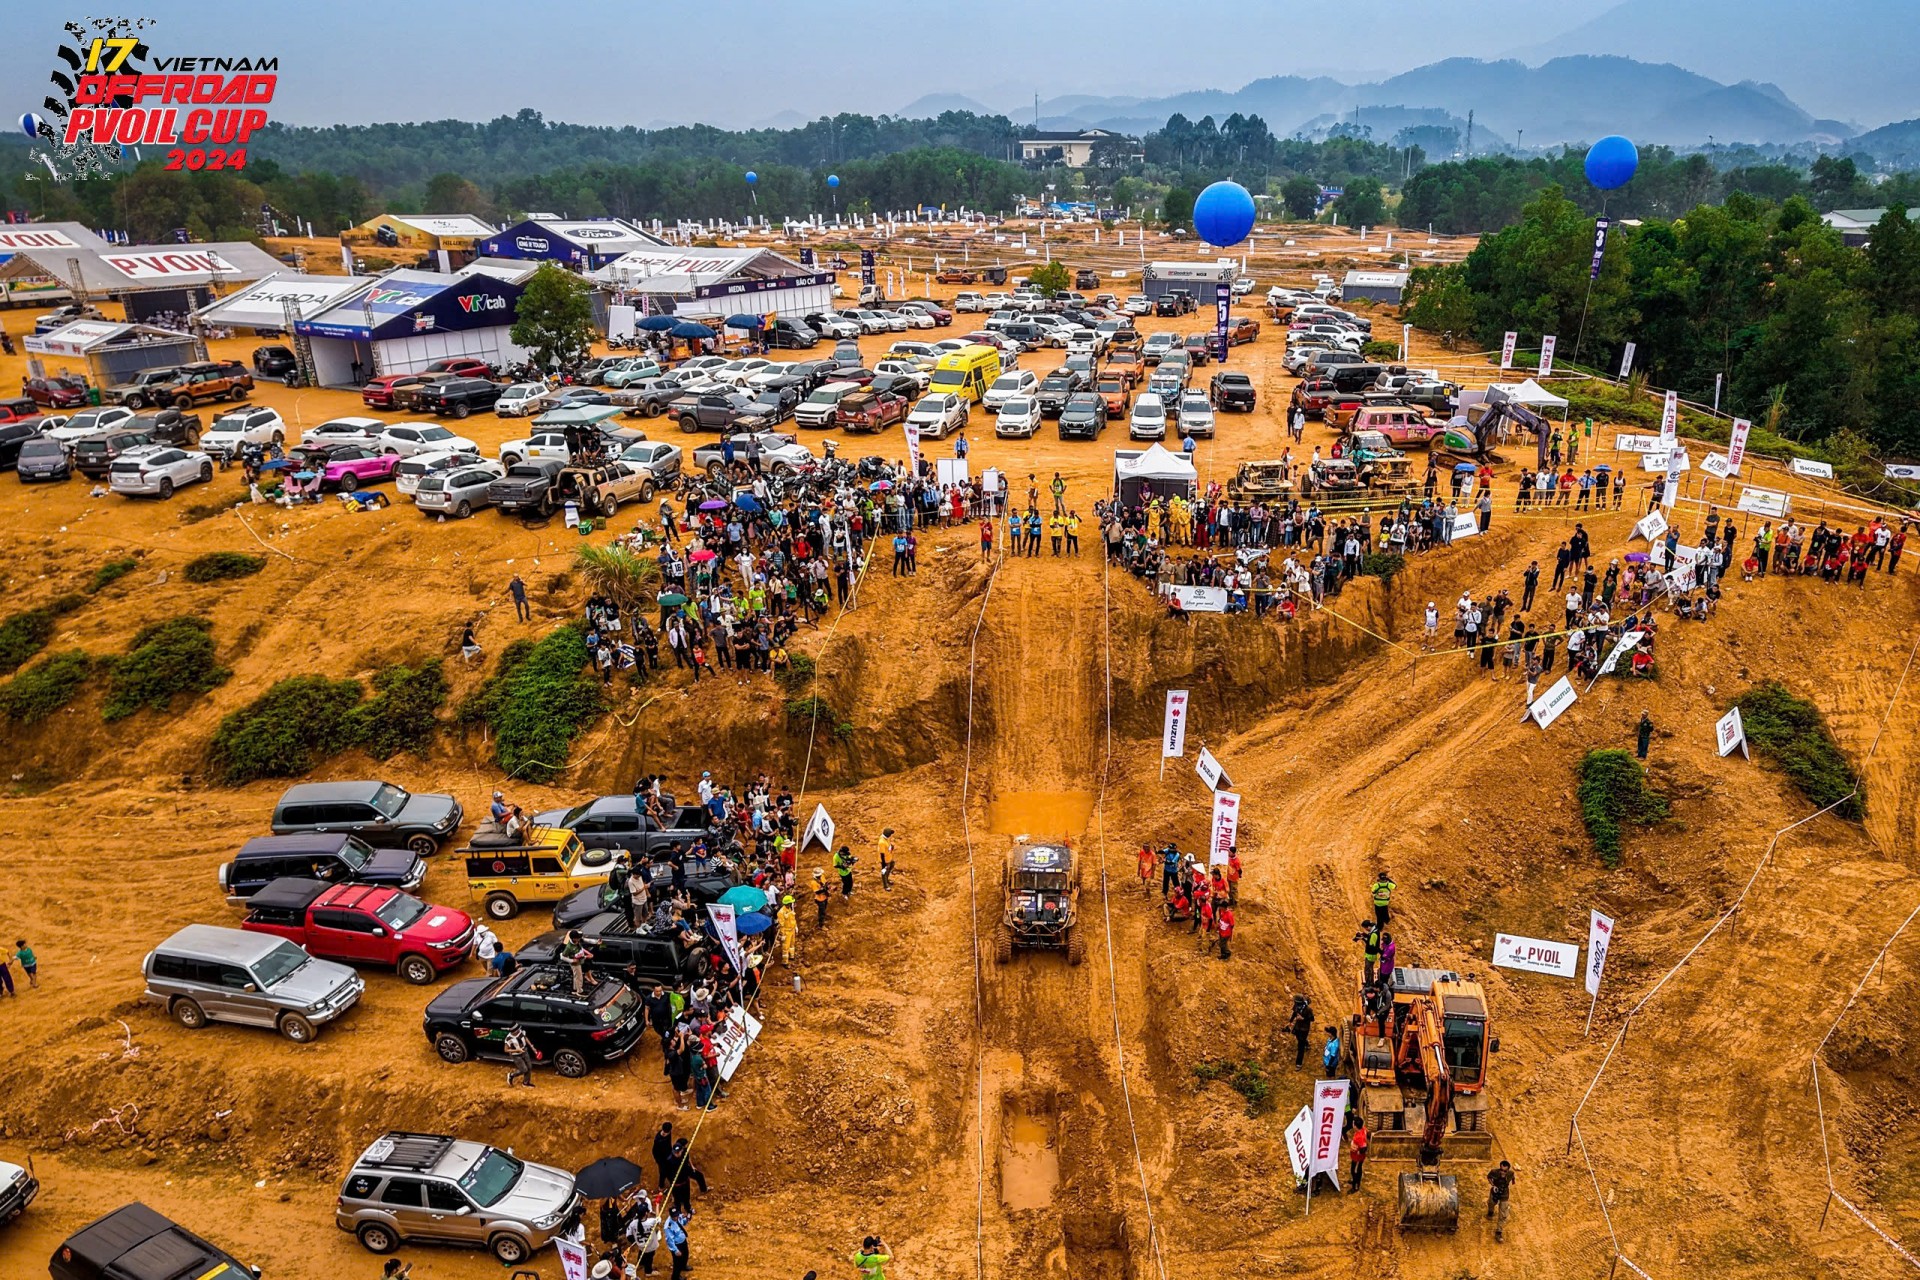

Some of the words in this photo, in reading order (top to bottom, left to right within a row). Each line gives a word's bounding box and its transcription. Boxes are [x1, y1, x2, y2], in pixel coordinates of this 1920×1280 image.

[0, 234, 72, 247] VOIL
[579, 230, 615, 238] Ford
[1596, 230, 1605, 247] 3
[108, 254, 232, 275] PVOIL
[666, 259, 734, 272] PVOIL
[728, 285, 746, 294] MEDIA
[458, 294, 506, 312] VTVcab
[1218, 300, 1227, 322] 5
[1666, 415, 1675, 434] PVOIL
[1635, 439, 1653, 448] PVOIL
[1732, 445, 1742, 465] PVOIL
[1170, 718, 1178, 750] SUZUKI
[1202, 764, 1215, 781] SUZUKI
[1218, 826, 1232, 853] PVOIL
[1528, 947, 1561, 964] PVOIL
[1592, 940, 1605, 979] Ford
[1318, 1106, 1335, 1160] ISUZU
[1293, 1128, 1309, 1171] ISUZU
